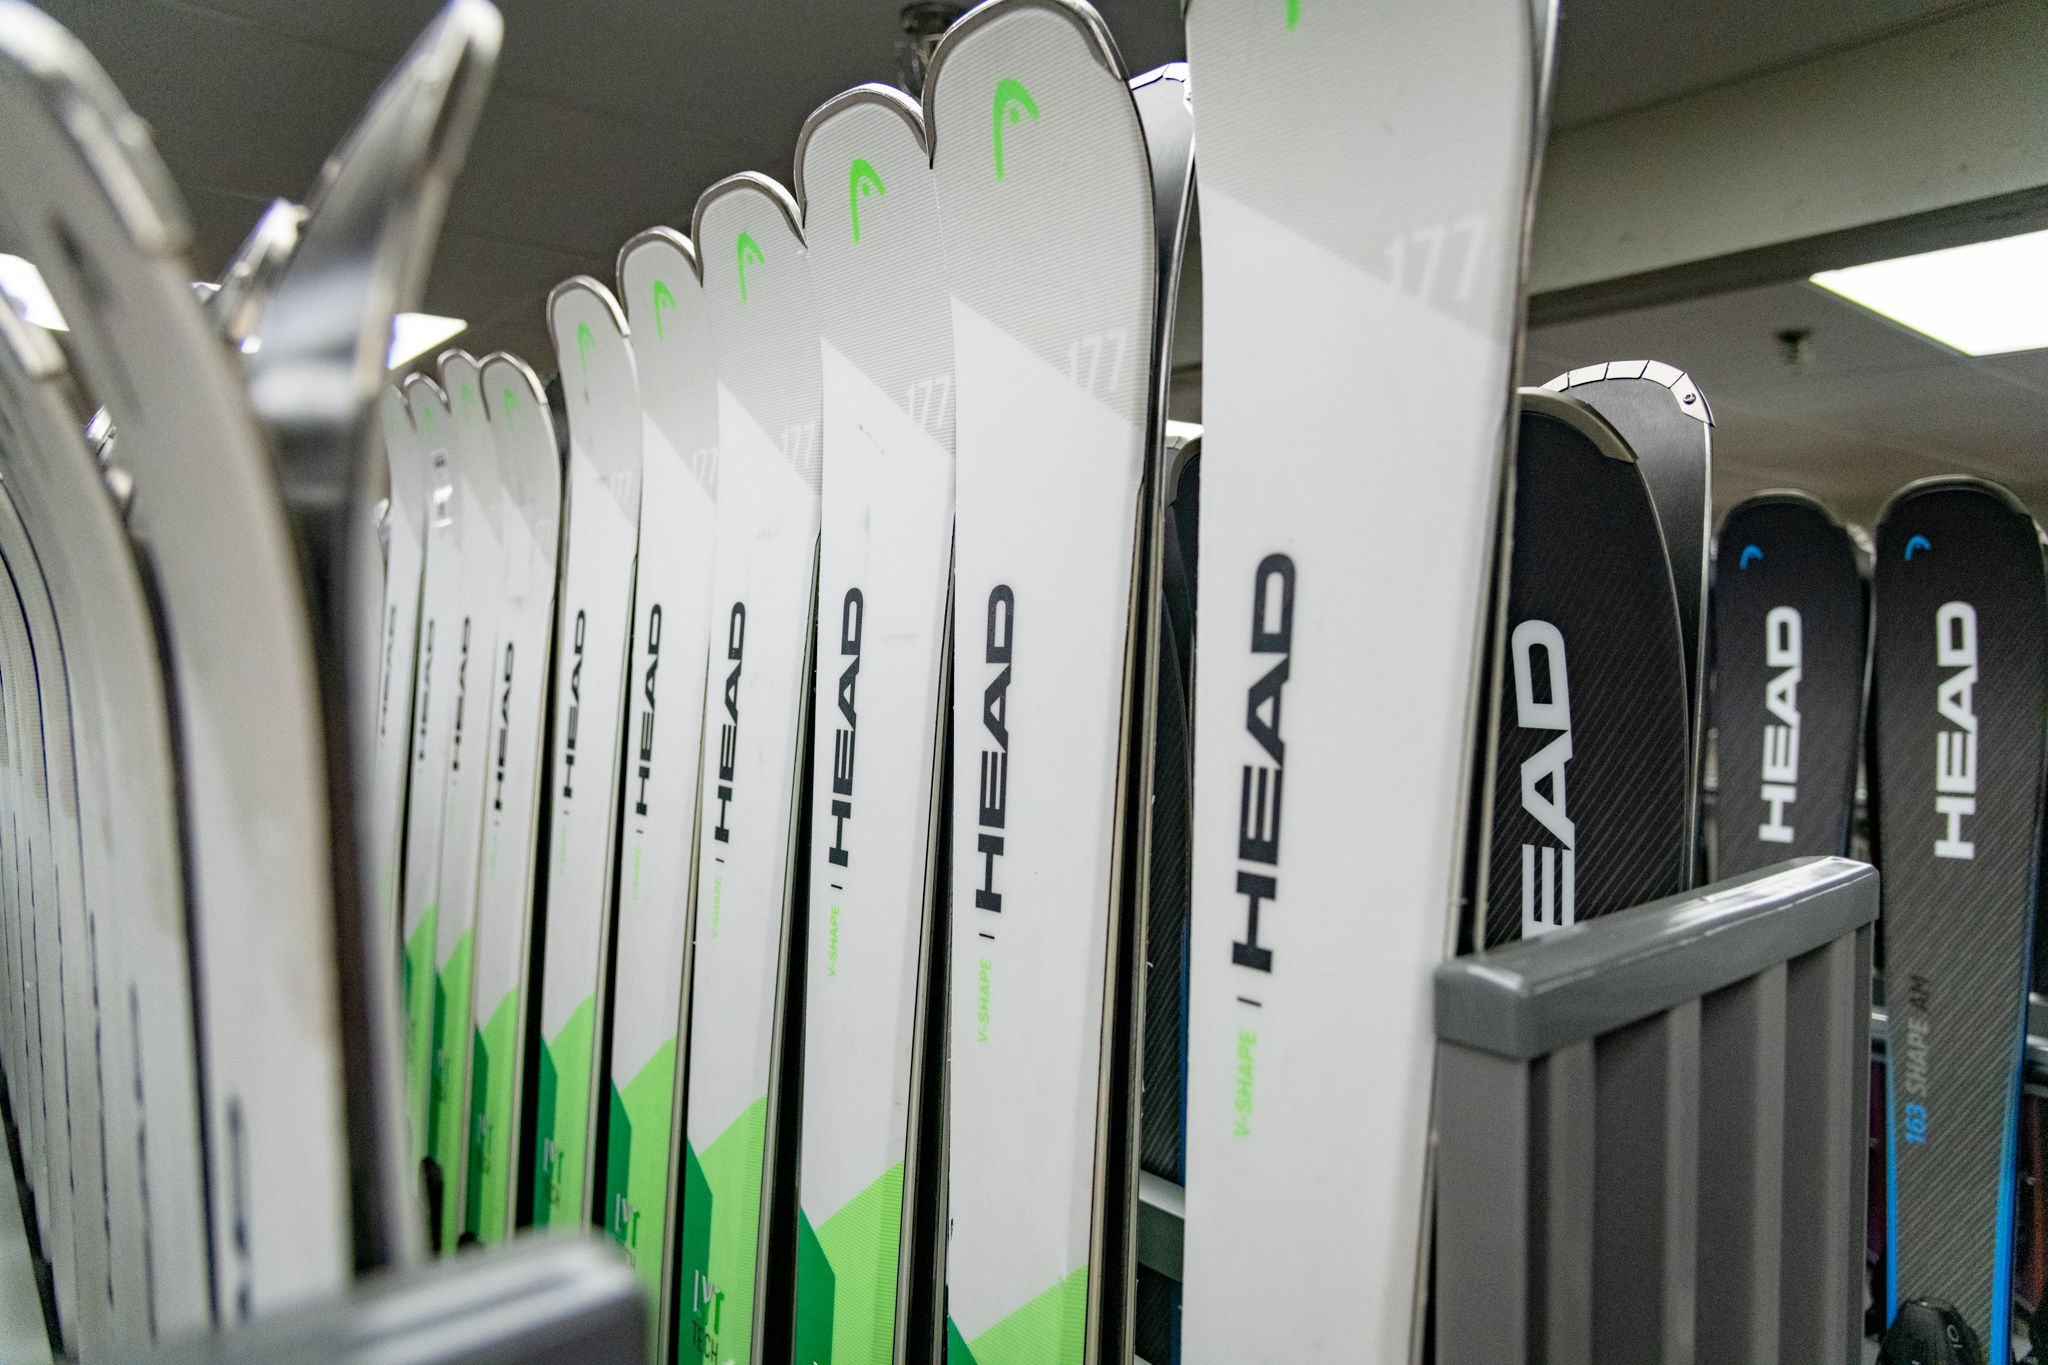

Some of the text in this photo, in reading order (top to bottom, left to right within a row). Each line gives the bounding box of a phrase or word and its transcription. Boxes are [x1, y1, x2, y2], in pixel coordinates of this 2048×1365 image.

[1066, 328, 1128, 393] 177
[1384, 215, 1489, 302] 177
[495, 641, 514, 811] HEAD
[563, 609, 586, 799] HEAD
[636, 603, 663, 816] HEAD
[714, 601, 746, 843] HEAD
[827, 587, 864, 977] V-SHAPE HEAD
[975, 584, 1014, 1043] V-SHAPE HEAD
[1511, 619, 1576, 941] EAD
[1759, 606, 1802, 844] HEAD
[1935, 601, 1978, 860] HEAD
[1233, 553, 1295, 1137] V-SHAPE HEAD
[1905, 1018, 1930, 1096] SHAPE
